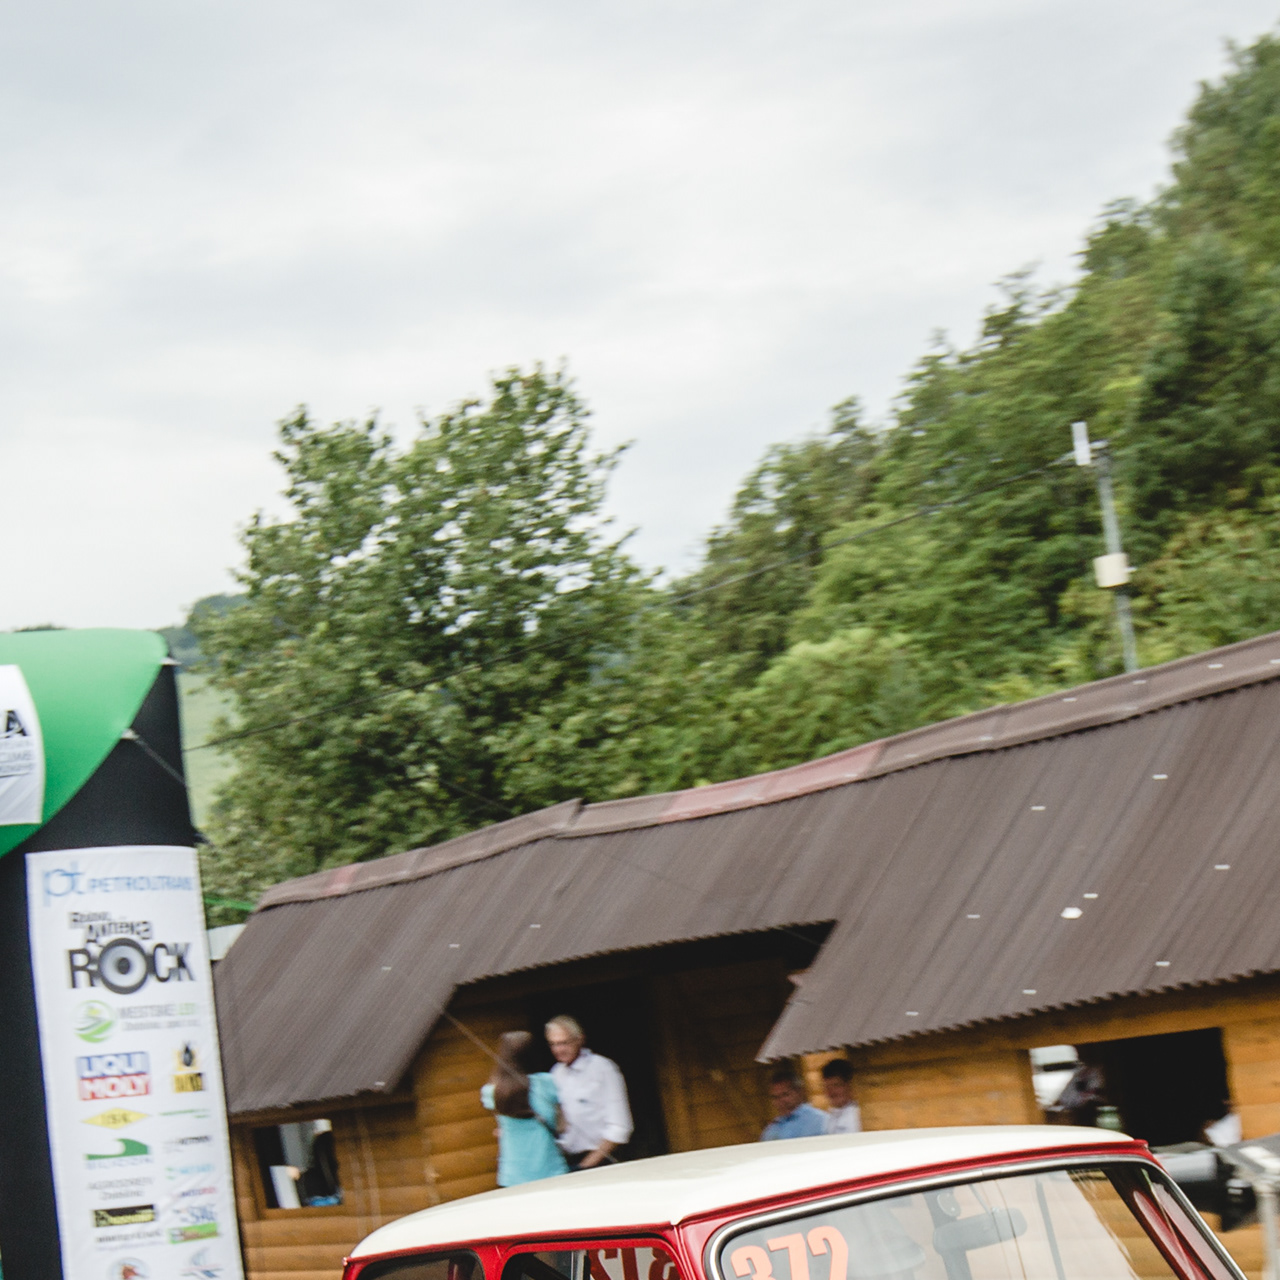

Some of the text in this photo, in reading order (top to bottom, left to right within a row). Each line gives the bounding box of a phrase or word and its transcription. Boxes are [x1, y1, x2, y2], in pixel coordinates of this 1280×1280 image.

[68, 937, 194, 995] ROCK
[82, 1053, 146, 1076] LIQUI
[82, 1076, 150, 1100] MOLY
